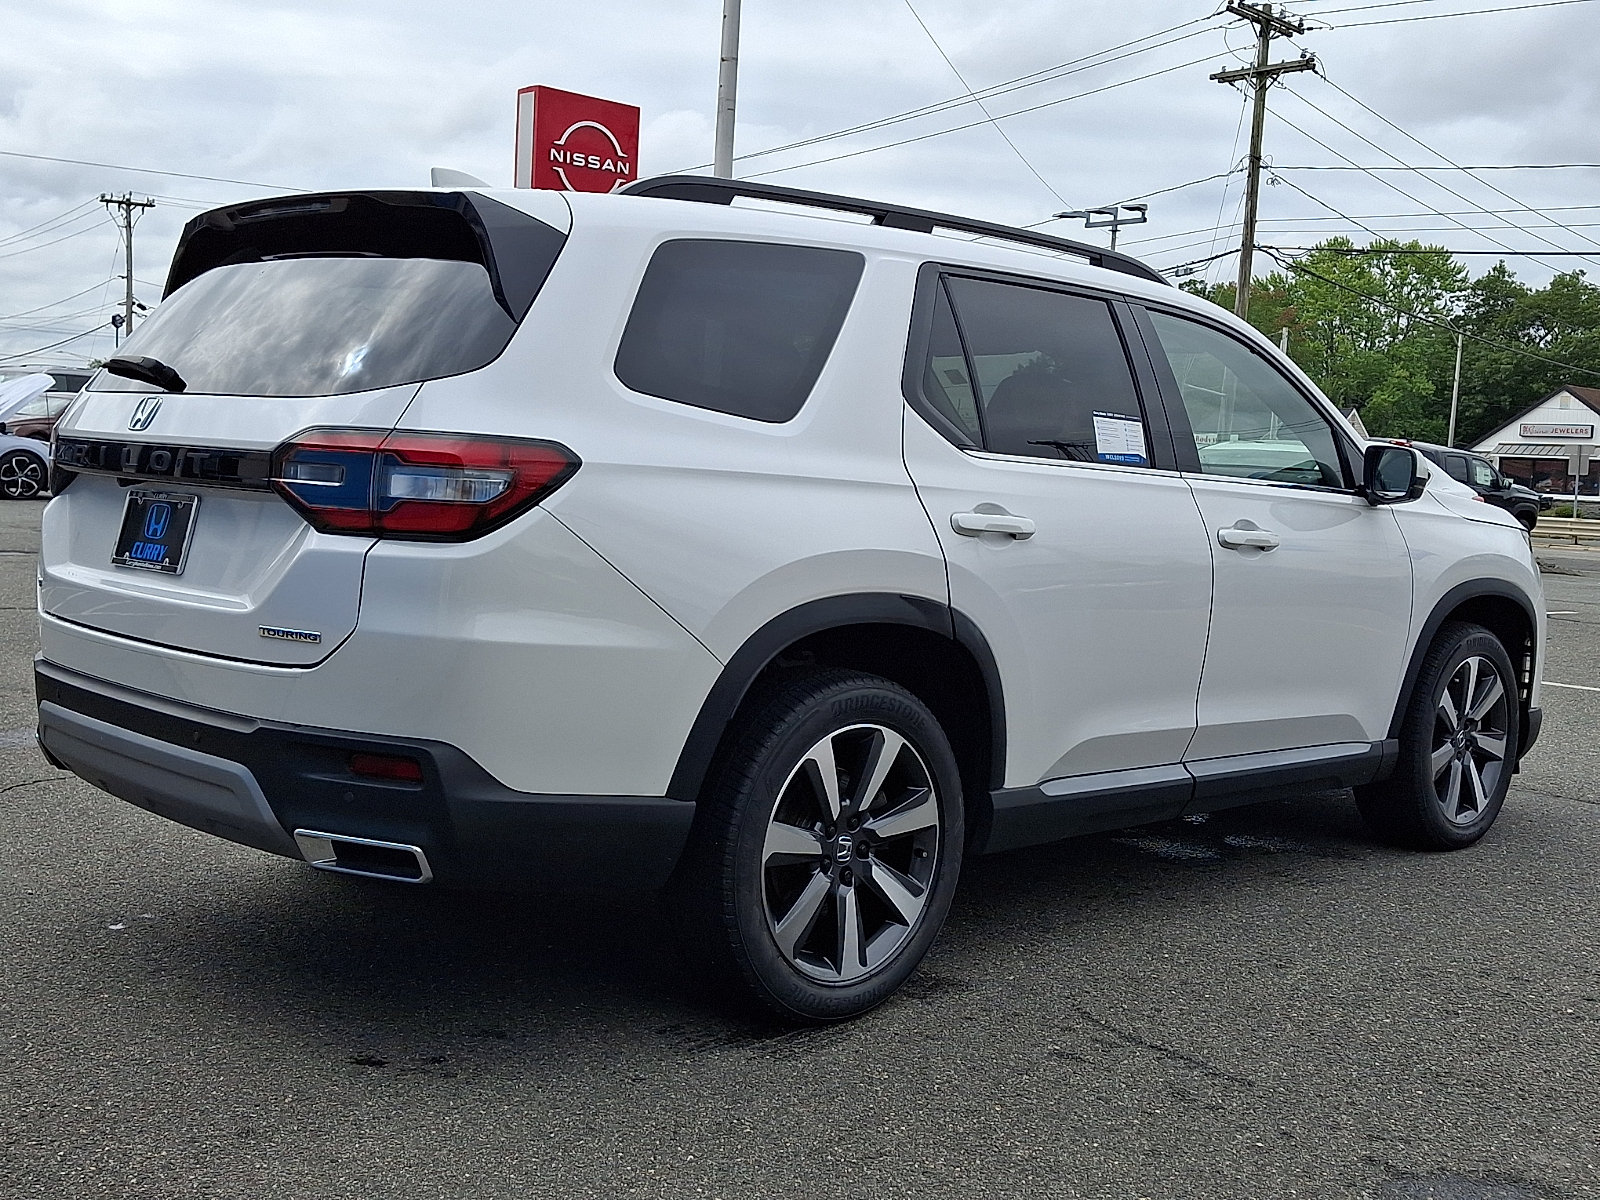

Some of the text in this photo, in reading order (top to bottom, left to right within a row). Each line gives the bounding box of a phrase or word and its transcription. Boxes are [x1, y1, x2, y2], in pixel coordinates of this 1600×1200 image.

[550, 148, 629, 175] NISSAN
[1551, 427, 1589, 435] JEWELERS
[131, 541, 169, 561] CURRY
[258, 627, 319, 641] TOURING
